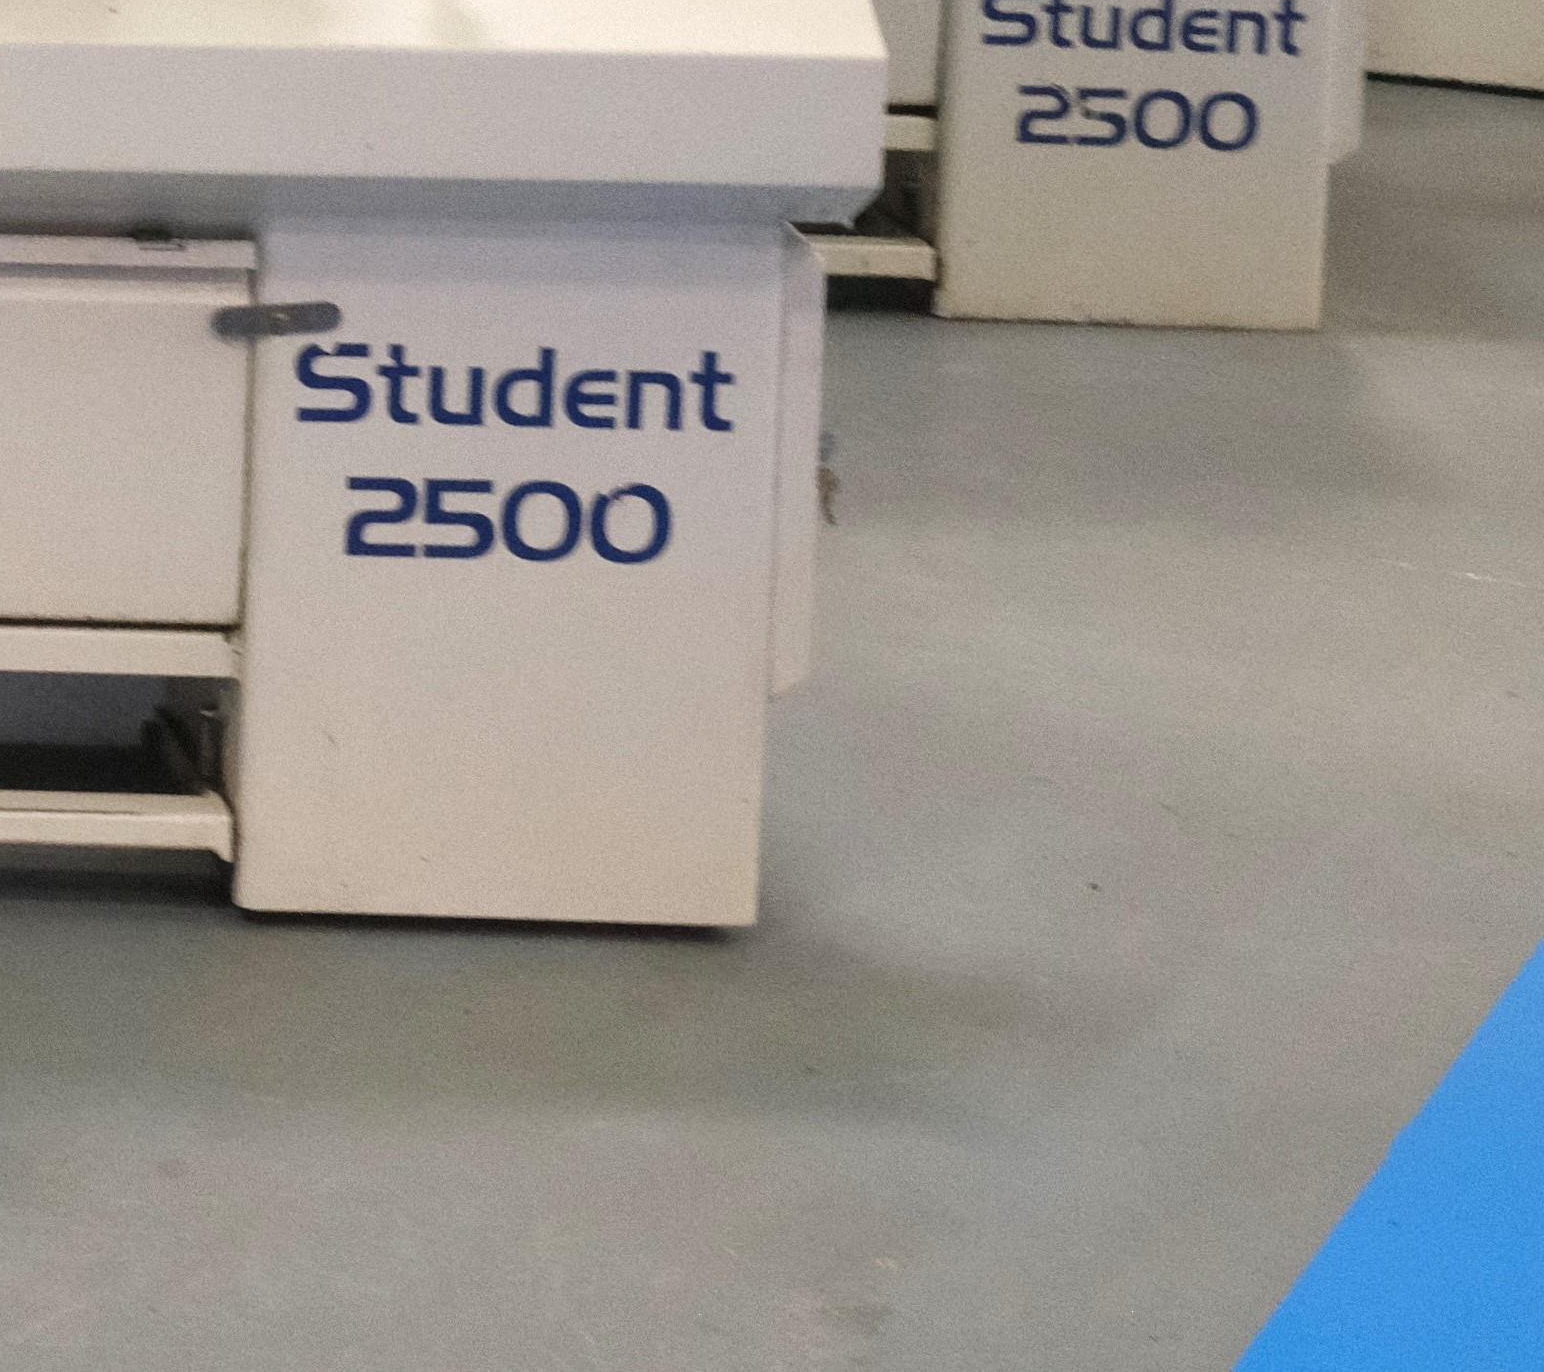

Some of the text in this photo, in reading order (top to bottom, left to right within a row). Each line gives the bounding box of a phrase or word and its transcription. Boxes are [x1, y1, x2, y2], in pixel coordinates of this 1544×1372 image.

[1016, 84, 1260, 152] 2500
[296, 342, 735, 432] Student
[344, 476, 672, 564] 2500
